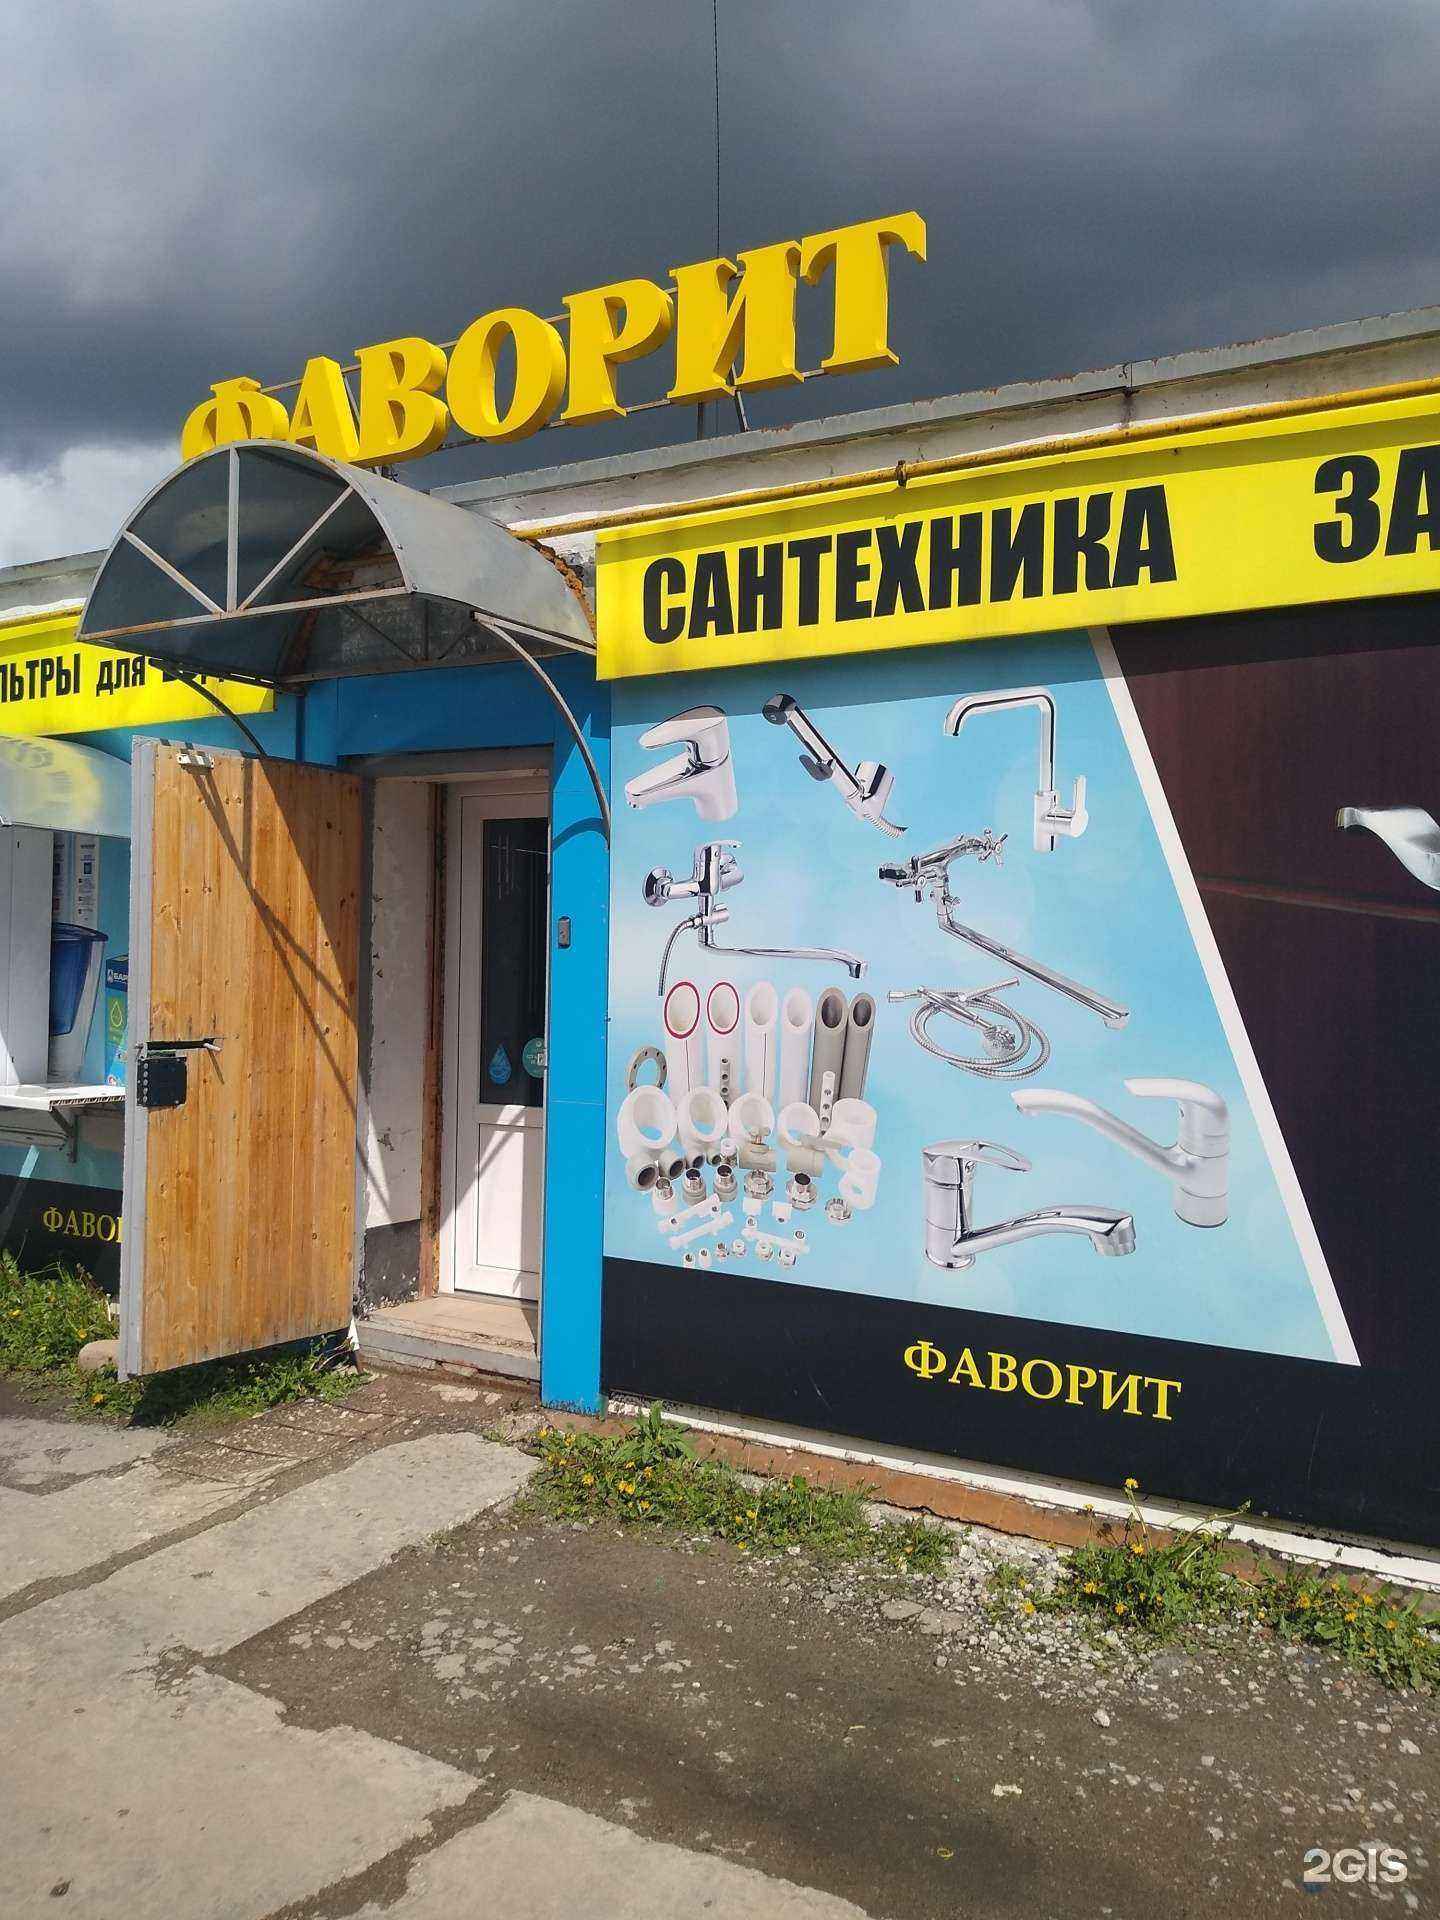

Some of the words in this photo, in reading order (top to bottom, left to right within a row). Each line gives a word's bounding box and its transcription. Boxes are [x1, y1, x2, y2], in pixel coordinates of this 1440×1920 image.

[181, 210, 928, 469] ФАВОРИТ
[642, 484, 1178, 645] САНТЕХНИКА
[1313, 444, 1440, 564] ЗА
[903, 1340, 1182, 1420] ФАВОРИТ
